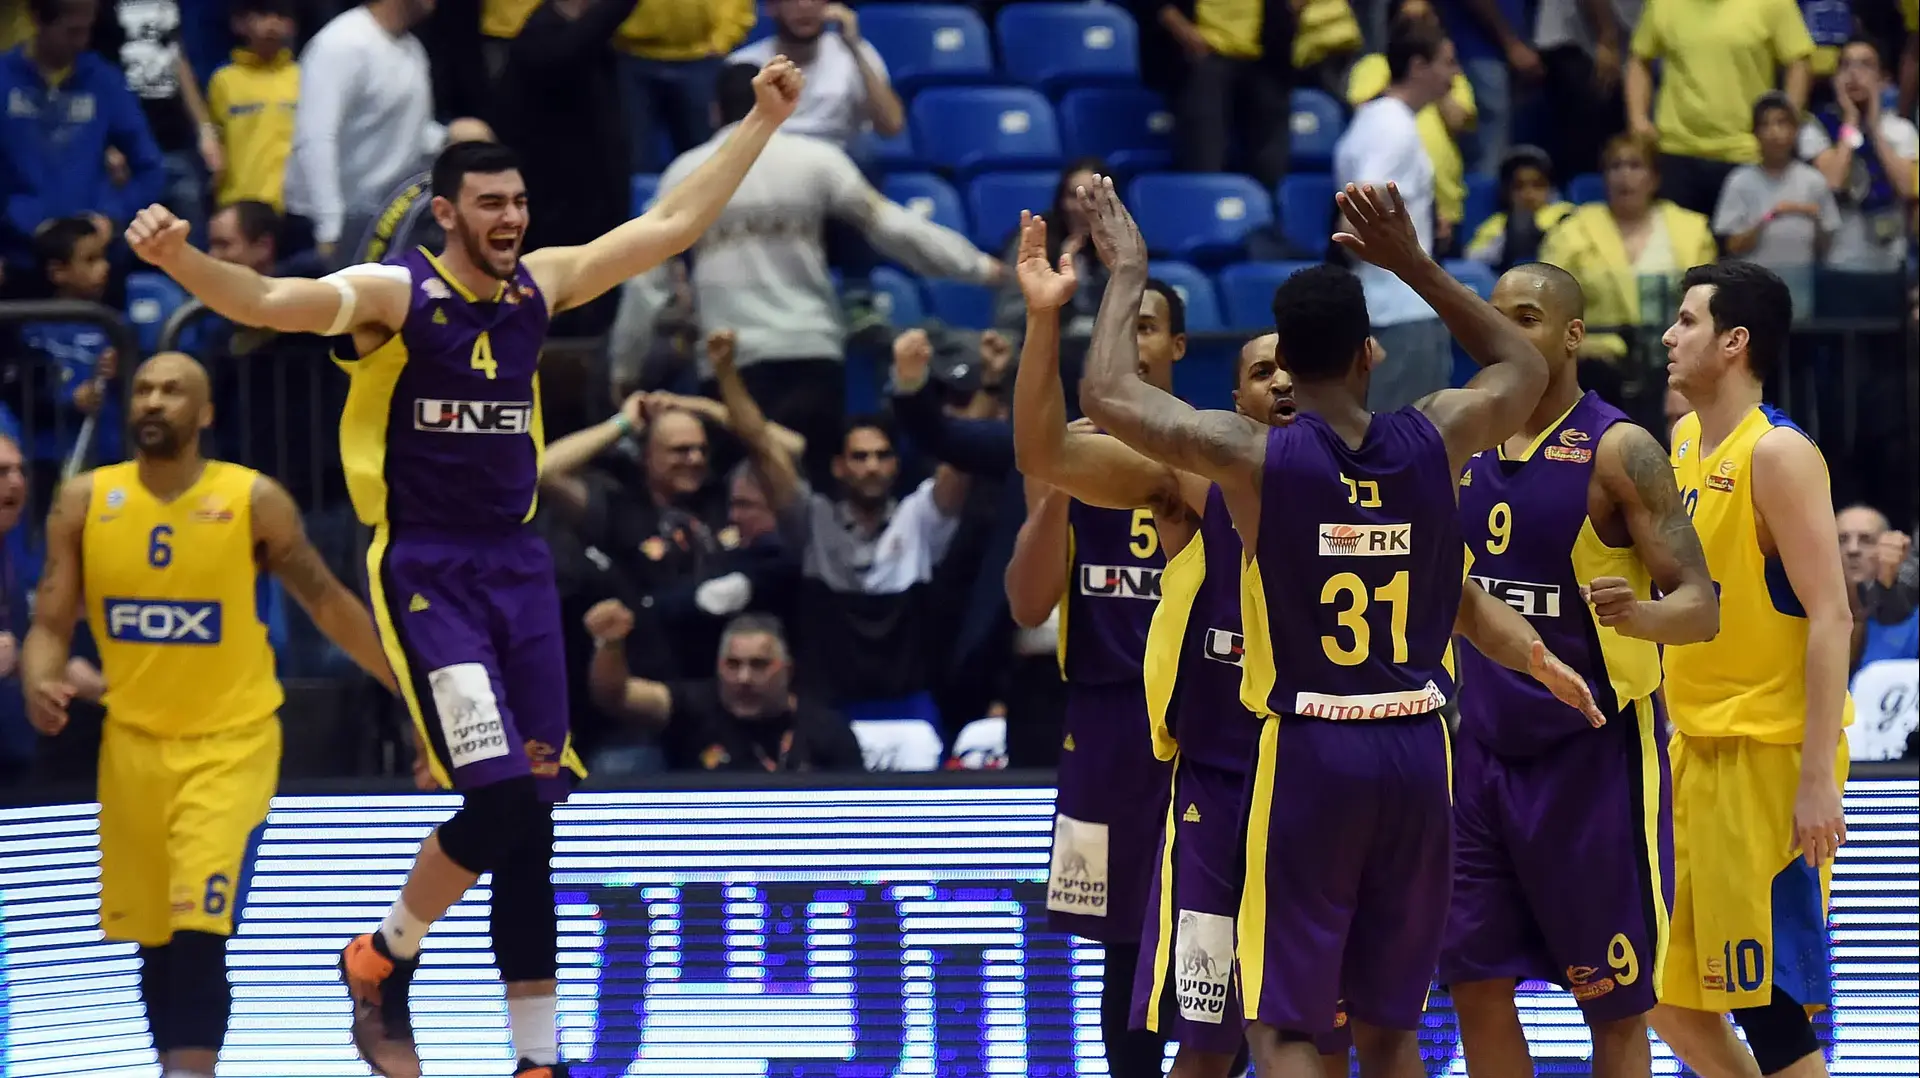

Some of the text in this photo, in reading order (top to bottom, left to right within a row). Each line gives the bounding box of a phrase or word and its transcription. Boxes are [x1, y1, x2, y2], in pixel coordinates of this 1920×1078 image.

[470, 331, 498, 380] 4
[148, 524, 173, 568] 6
[1129, 509, 1158, 559] 5
[1369, 529, 1409, 551] RK
[1486, 502, 1512, 555] 9
[111, 603, 213, 640] FOX
[1320, 570, 1410, 666] 31
[1301, 692, 1441, 721] AUTO CENTER
[204, 873, 229, 914] 6
[1607, 932, 1639, 986] 9
[1724, 938, 1765, 993] 10
[1179, 978, 1226, 998] מסיעי
